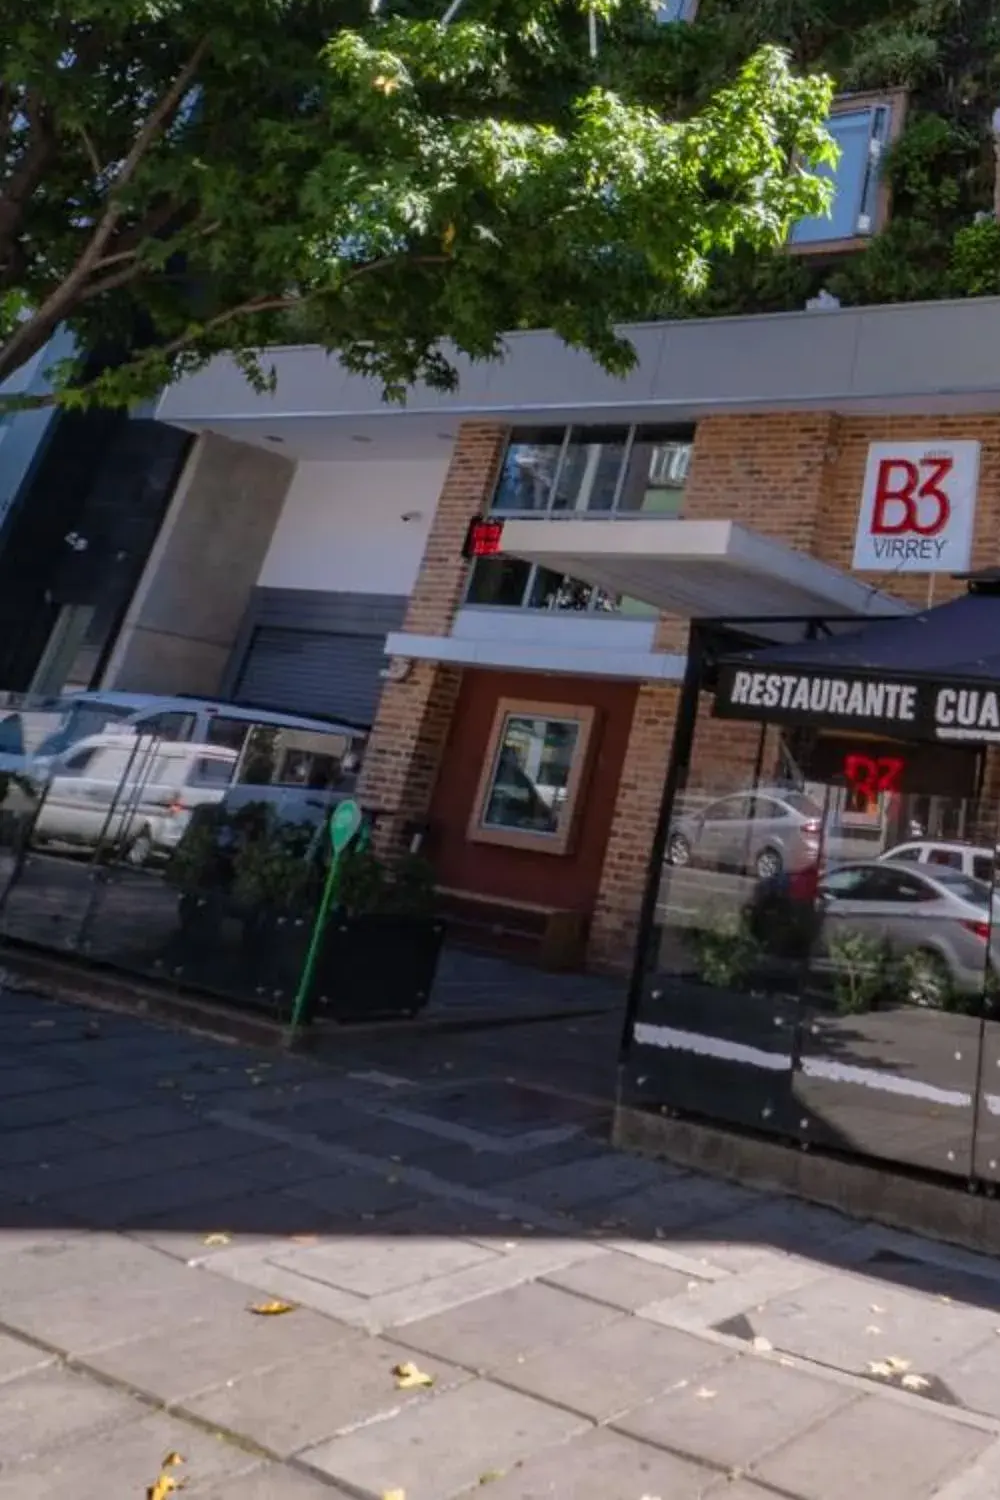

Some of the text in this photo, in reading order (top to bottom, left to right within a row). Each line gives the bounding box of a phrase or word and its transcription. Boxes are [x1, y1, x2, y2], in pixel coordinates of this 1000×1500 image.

[870, 457, 953, 536] B3
[872, 537, 947, 560] VIRREY
[730, 671, 917, 721] RESTAURANTE
